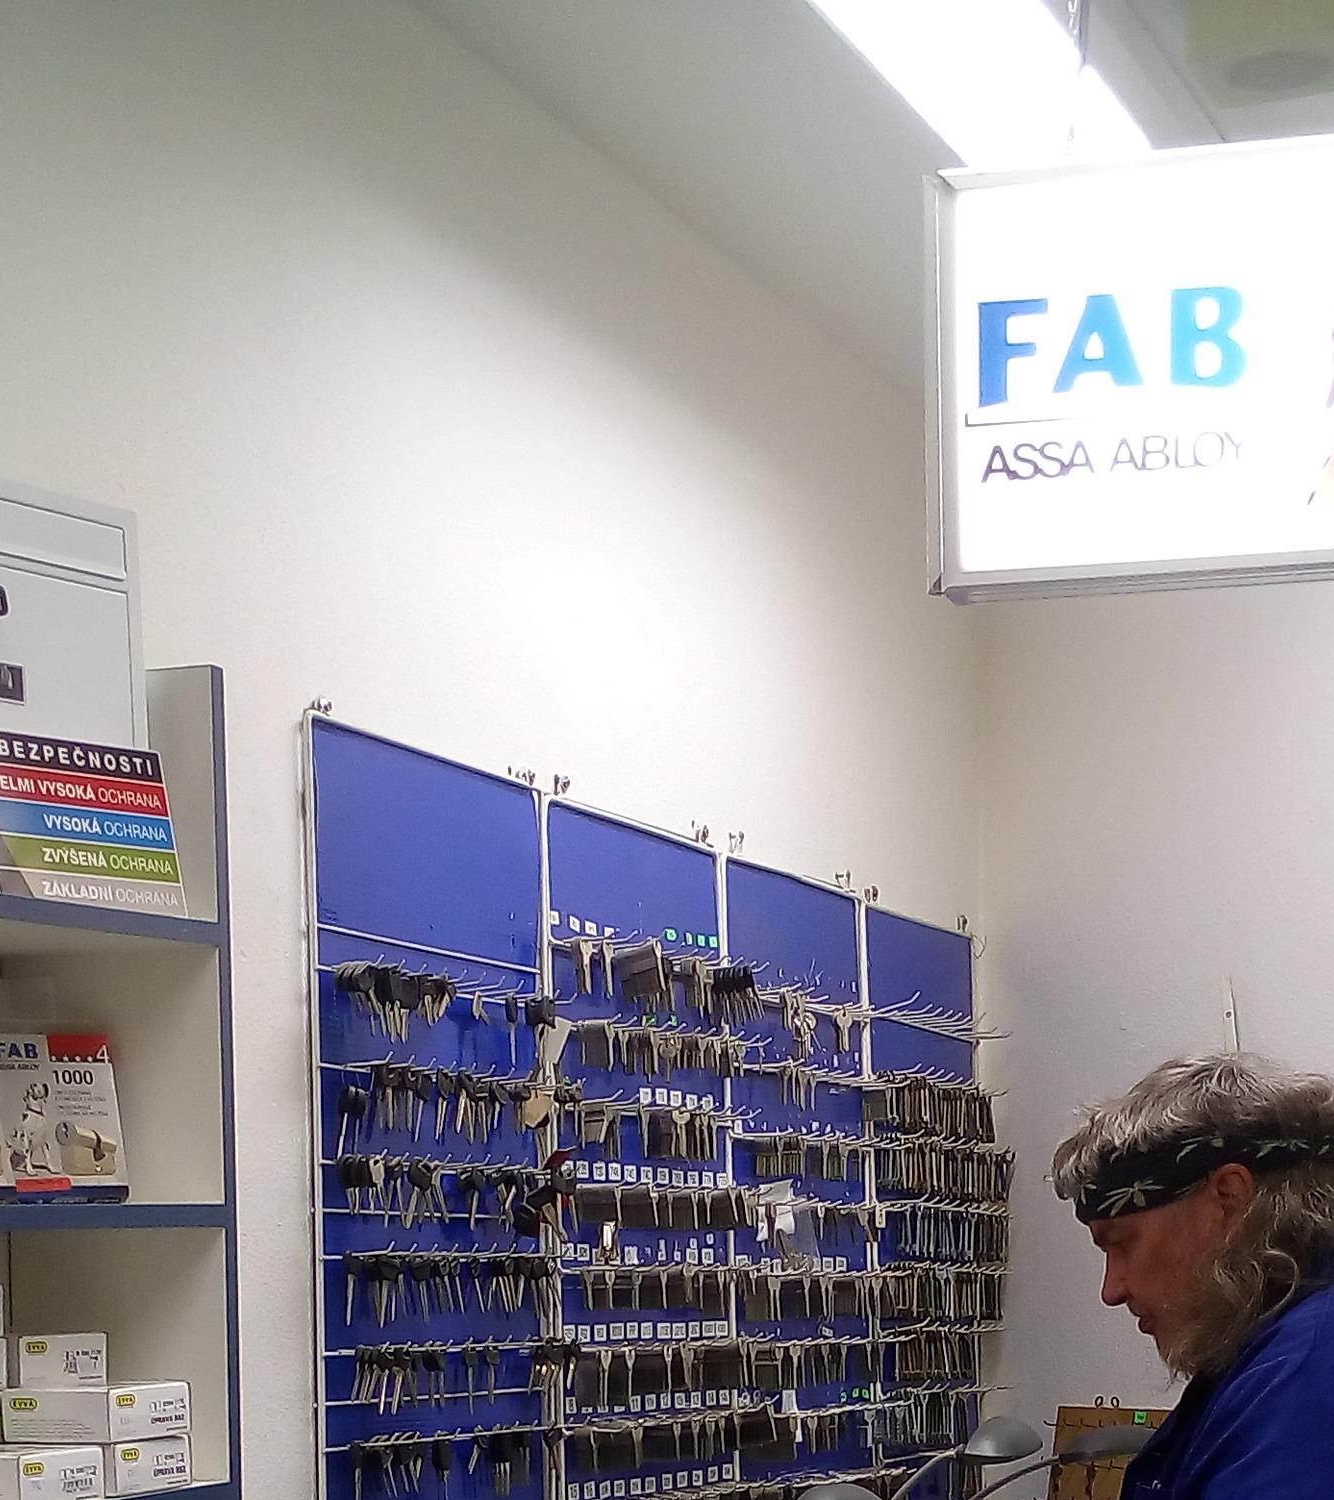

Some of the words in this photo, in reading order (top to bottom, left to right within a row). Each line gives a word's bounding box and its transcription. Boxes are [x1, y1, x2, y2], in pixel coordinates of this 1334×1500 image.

[978, 286, 1246, 408] FAB
[981, 441, 1095, 483] ASSA
[1110, 431, 1243, 473] ABLOY
[38, 779, 97, 801] VYSOKÁ
[97, 787, 163, 810] OCHRANA
[42, 813, 103, 835] VYSOKÁ
[104, 821, 168, 842] OCHRANA
[41, 847, 108, 868] ZVÝŠENÁ
[109, 853, 174, 875] OCHRANA
[42, 879, 114, 901] ZÁKLADNÍ
[115, 888, 179, 907] OCHRANA
[96, 1044, 110, 1064] 4
[52, 1070, 94, 1085] 1000
